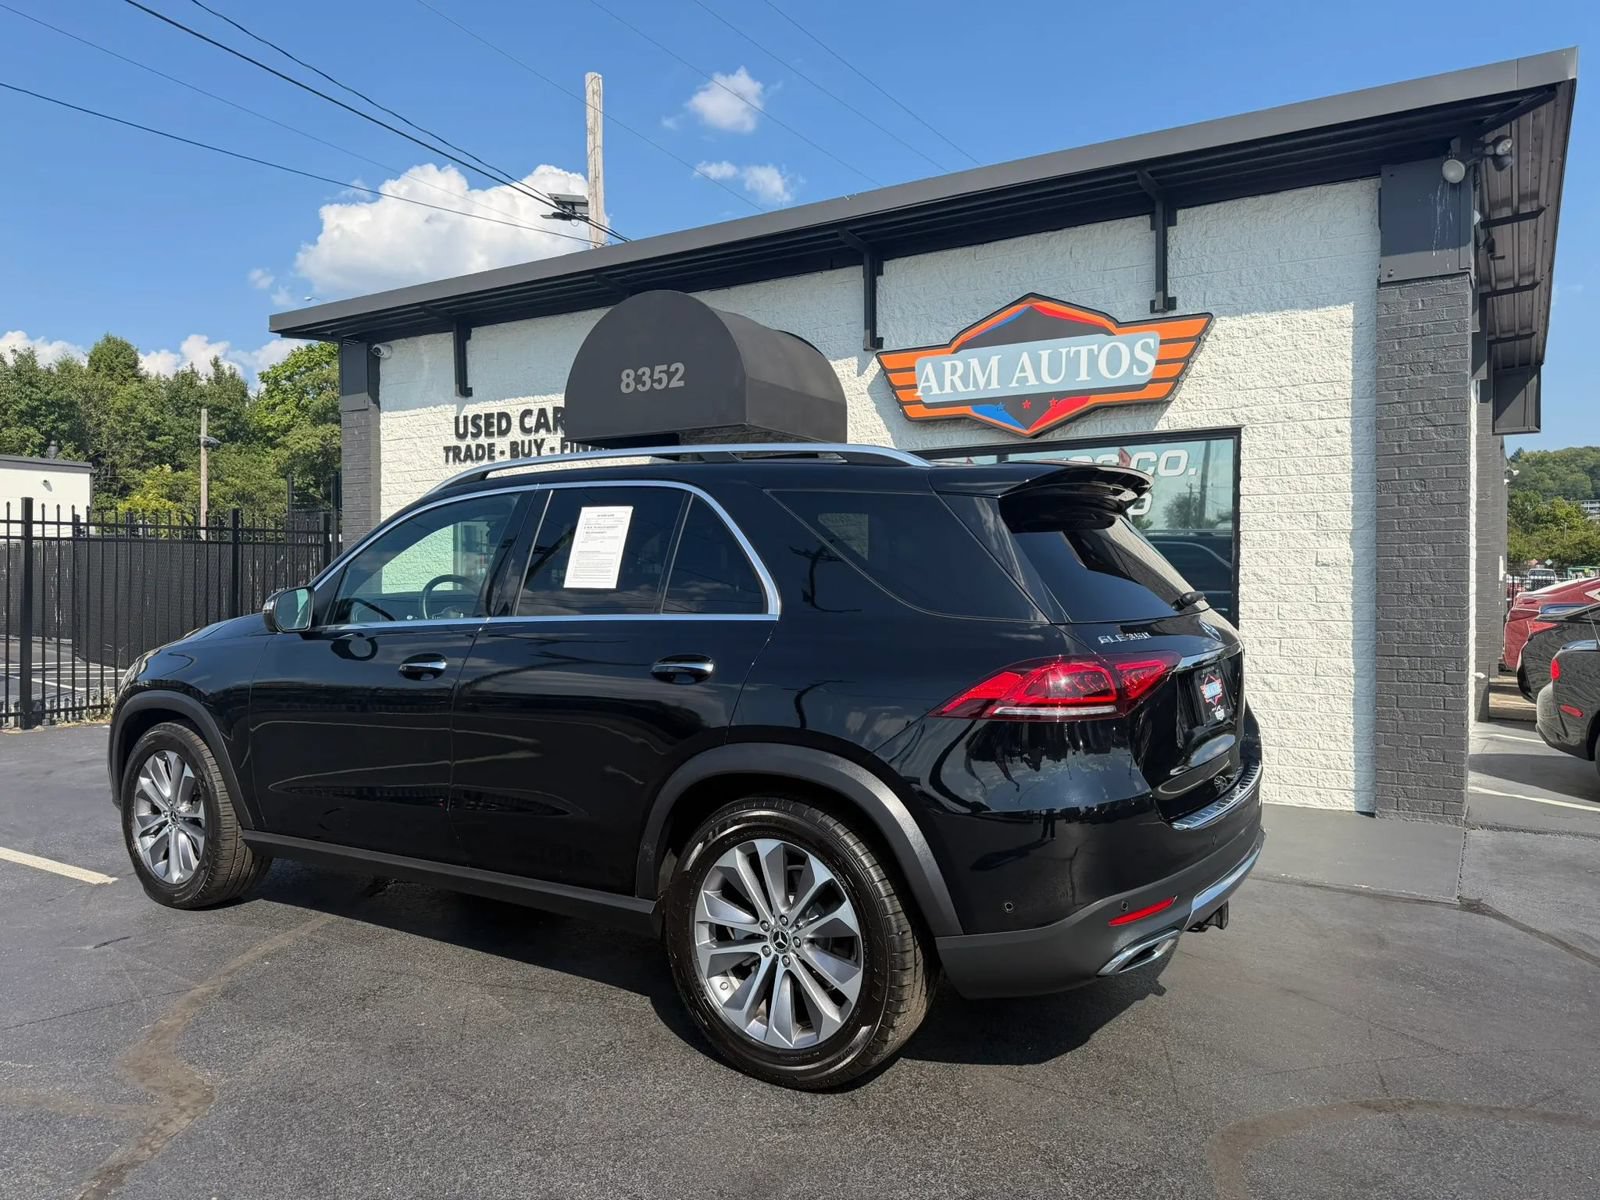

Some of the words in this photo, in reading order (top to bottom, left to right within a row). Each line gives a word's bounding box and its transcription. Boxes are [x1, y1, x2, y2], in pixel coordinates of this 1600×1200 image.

[620, 362, 685, 394] 8352
[916, 354, 1001, 396] ARM
[1010, 338, 1156, 386] AUTOS
[454, 411, 512, 439] USED
[443, 443, 495, 463] TRADE
[510, 438, 545, 458] BUY
[1097, 634, 1127, 644] GLE
